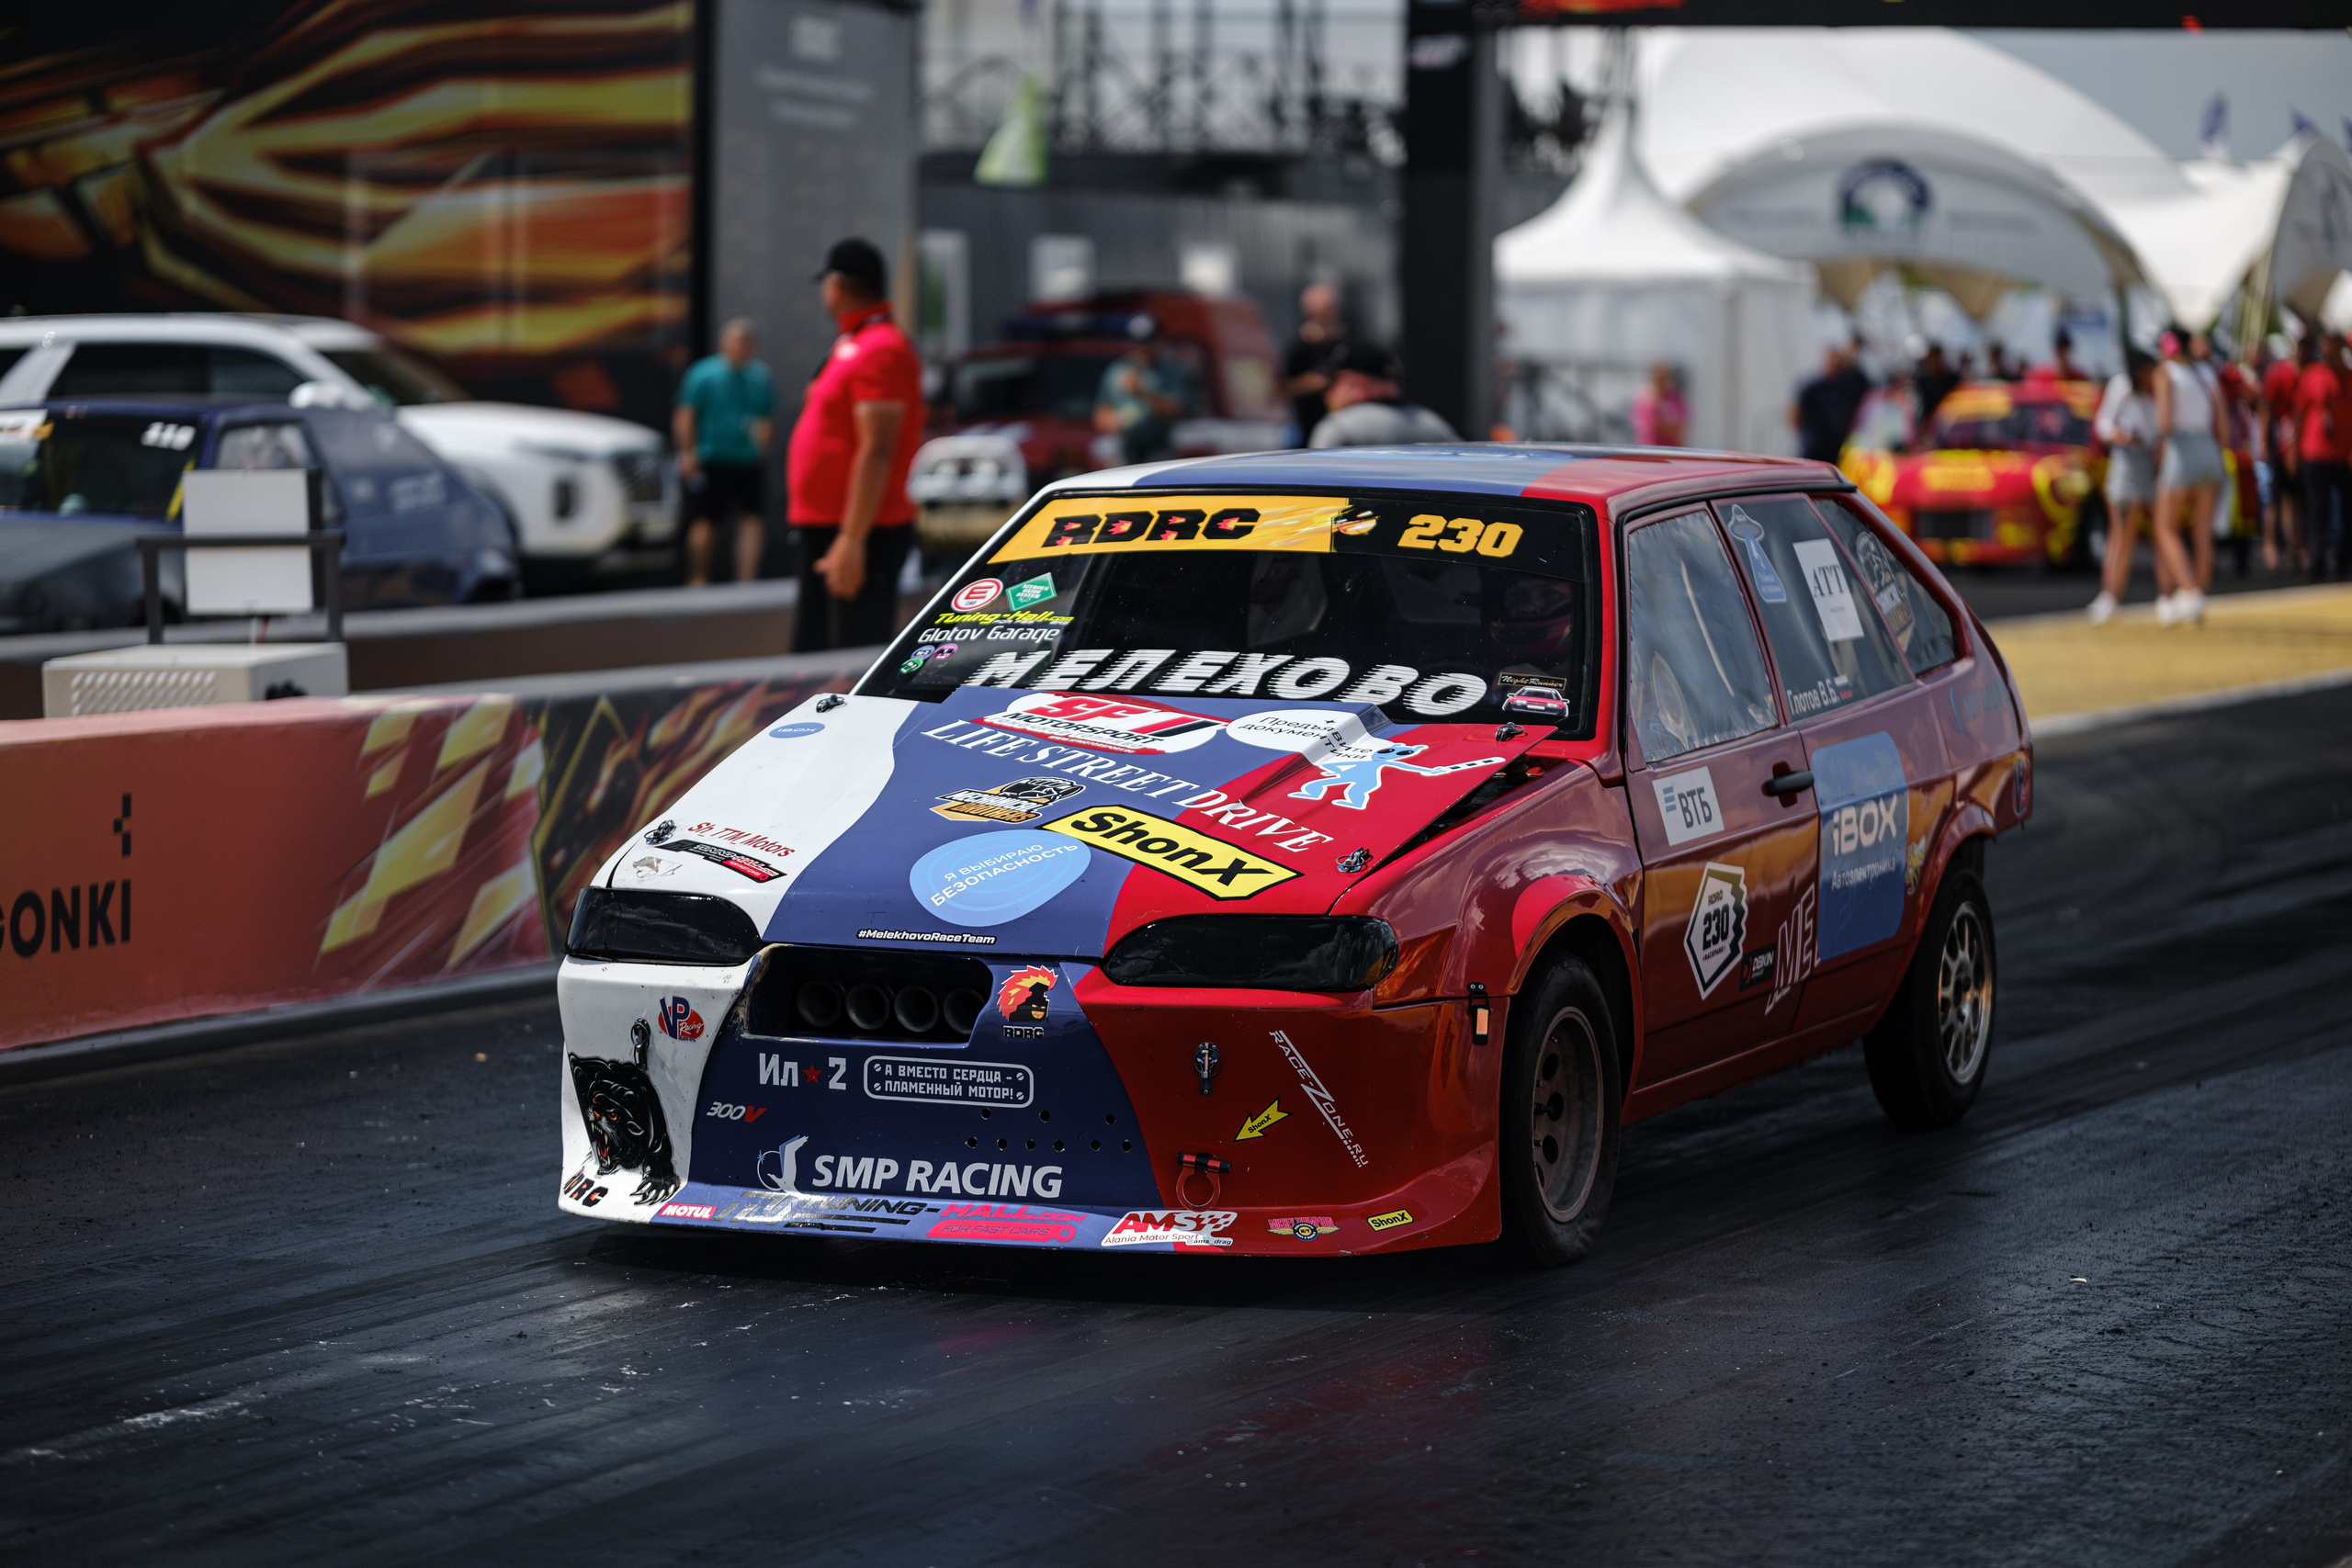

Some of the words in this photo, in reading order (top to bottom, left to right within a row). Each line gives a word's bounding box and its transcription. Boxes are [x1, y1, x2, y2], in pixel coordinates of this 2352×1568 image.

[1041, 508, 1261, 547] RDRC
[1397, 514, 1524, 558] 230
[934, 611, 1074, 625] Tuning-Hall.com
[918, 626, 985, 643] Glotov
[987, 626, 1060, 643] Garage
[961, 649, 1487, 716] МЕЛЕХОВО
[1501, 675, 1529, 684] Night
[1786, 689, 1821, 716] Глотов
[1002, 712, 1164, 745] MOTORSPORT
[1260, 716, 1373, 754] Предъявите
[920, 719, 1039, 758] LIFE
[1014, 739, 1200, 807] STREET
[1171, 789, 1334, 853] DRIVE
[944, 791, 1043, 813] MECHANICAL
[950, 802, 1036, 822] BROTHERS
[1678, 786, 1713, 829] ВТБ
[1833, 794, 1897, 856] iBOX
[1070, 812, 1275, 886] ShonX
[944, 872, 957, 881] Я
[958, 843, 1044, 876] ВЫБИРАЮ
[930, 842, 1080, 907] БЕЗОПАСНОСТЬ
[1831, 858, 1896, 891] Автоэлектроника
[857, 930, 995, 944] #MelekhovoRaceTeam
[1702, 903, 1730, 951] 230
[1704, 947, 1724, 961] RACEPARK
[659, 996, 690, 1040] VP
[680, 1021, 704, 1035] Racing
[1003, 1026, 1044, 1039] RDRC
[829, 1057, 846, 1089] 2
[885, 1066, 893, 1076] А
[899, 1066, 946, 1079] ВМЕСТО
[954, 1068, 1001, 1083] СЕРДЦА
[885, 1080, 962, 1097] ПЛАМЕННЫЙ
[968, 1086, 1014, 1100] МОТОР!
[707, 1101, 766, 1122] 300V
[1248, 1112, 1272, 1134] ShonX
[813, 1155, 899, 1190] SMP
[905, 1161, 1063, 1199] RACING
[661, 1204, 713, 1218] MOTUL
[1371, 1212, 1409, 1229] ShonX
[942, 1224, 974, 1234] FOR
[975, 1224, 1008, 1235] FAST
[1010, 1226, 1050, 1236] CARS
[1112, 1213, 1198, 1235] AMS
[1268, 1217, 1295, 1229] MICKEY
[1104, 1235, 1136, 1245] Alania
[1139, 1234, 1170, 1242] Motor
[1171, 1233, 1199, 1241] Sport
